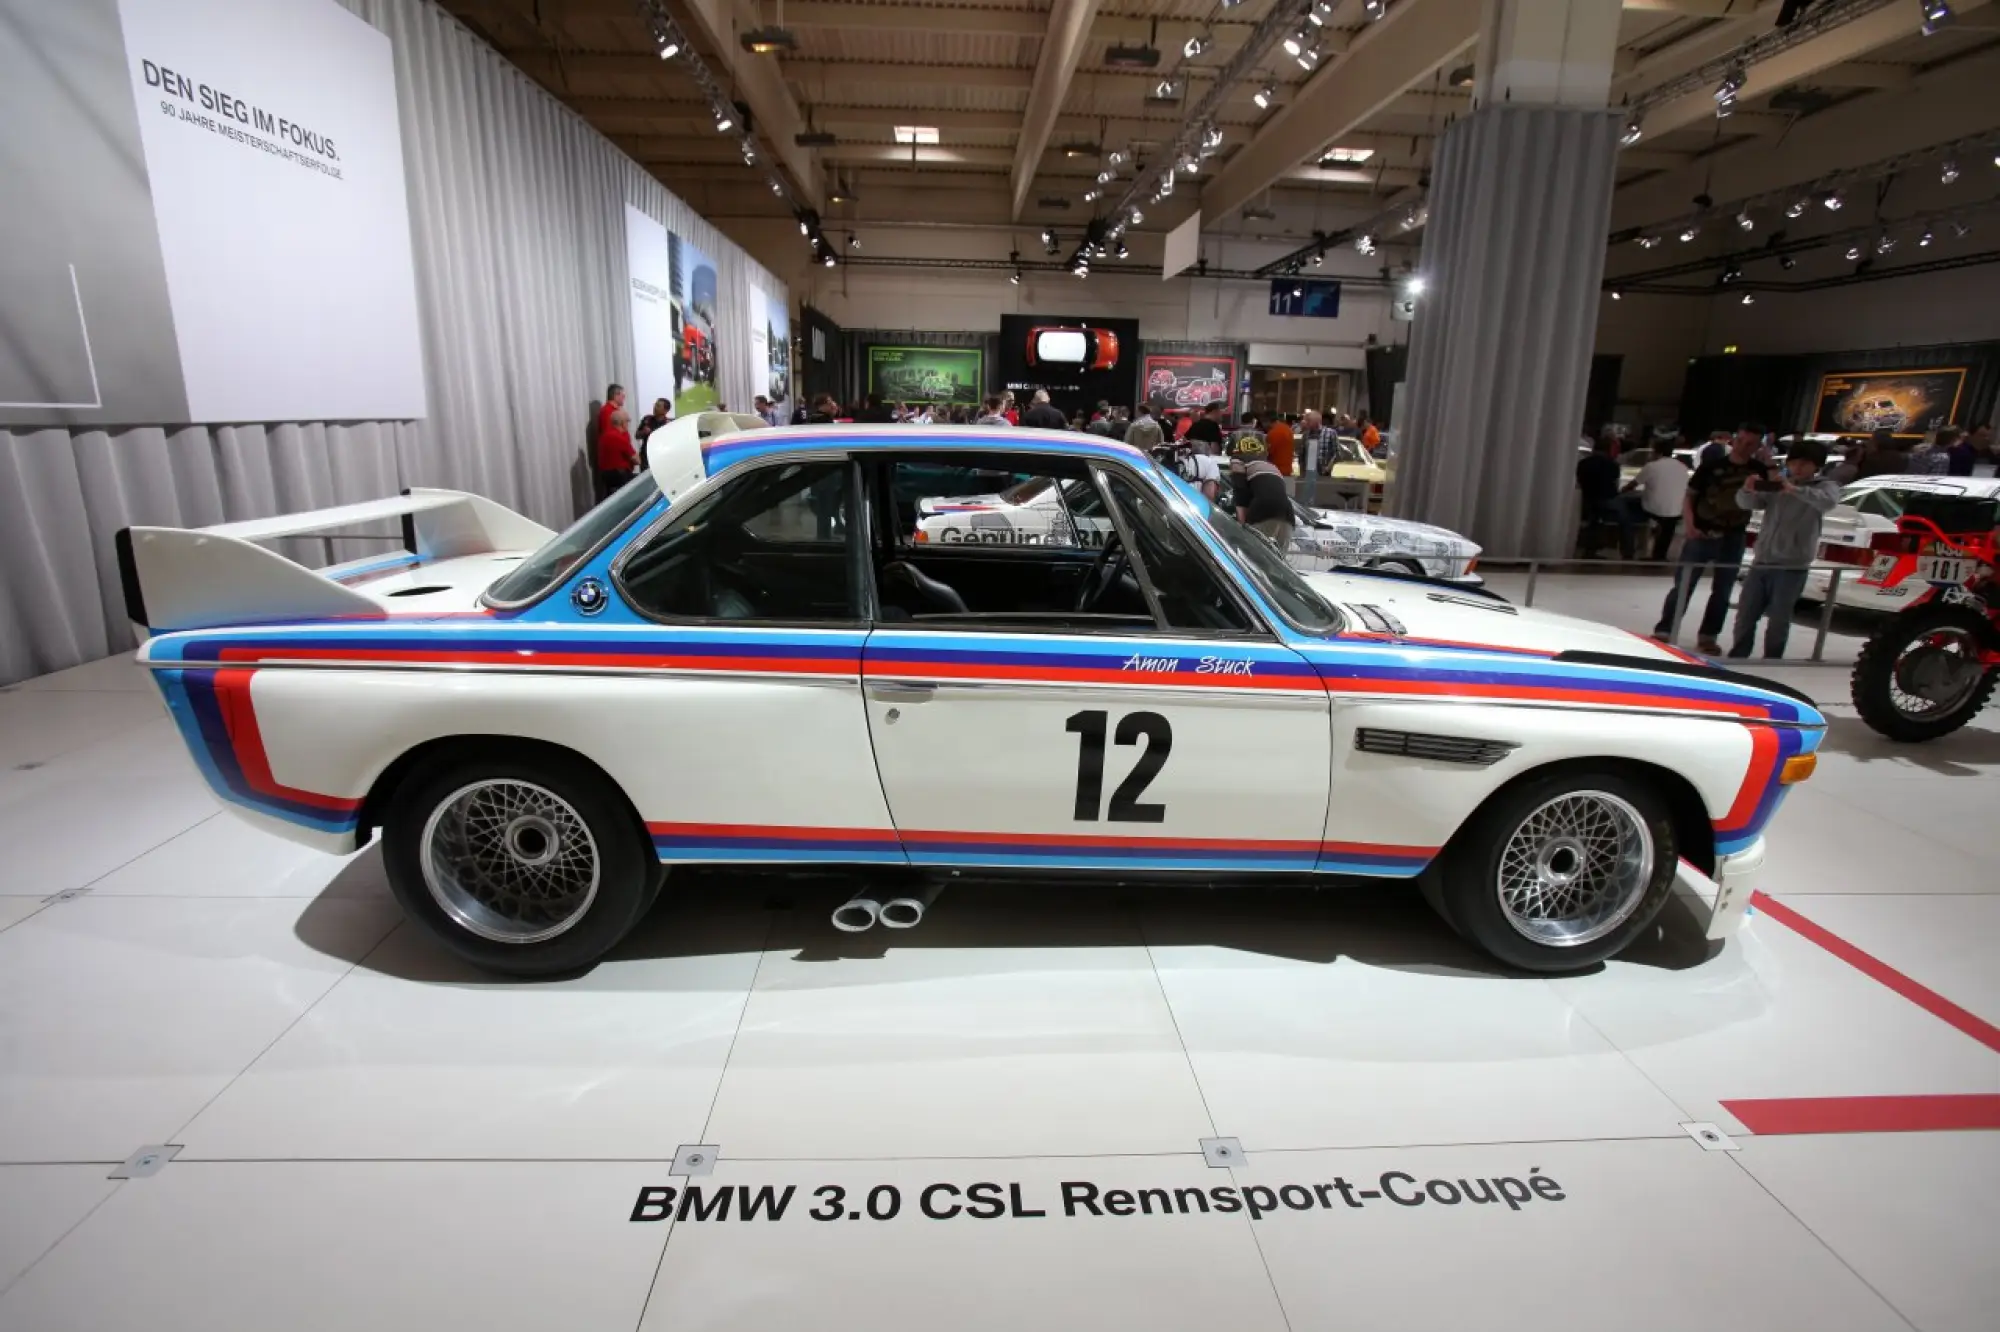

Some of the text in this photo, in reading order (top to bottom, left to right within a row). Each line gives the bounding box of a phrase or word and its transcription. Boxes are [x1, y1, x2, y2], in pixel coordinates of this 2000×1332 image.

[142, 58, 341, 161] DEN SIEG IM FOKUS.
[160, 100, 176, 118] 90
[178, 108, 217, 134] JAHRE
[1271, 292, 1292, 314] 11
[1931, 559, 1960, 580] 101
[1122, 652, 1255, 678] Amon Stuck
[1065, 709, 1173, 823] 12
[629, 1166, 1567, 1222] BMW 3.0 CSL Rennsport-Coupé
